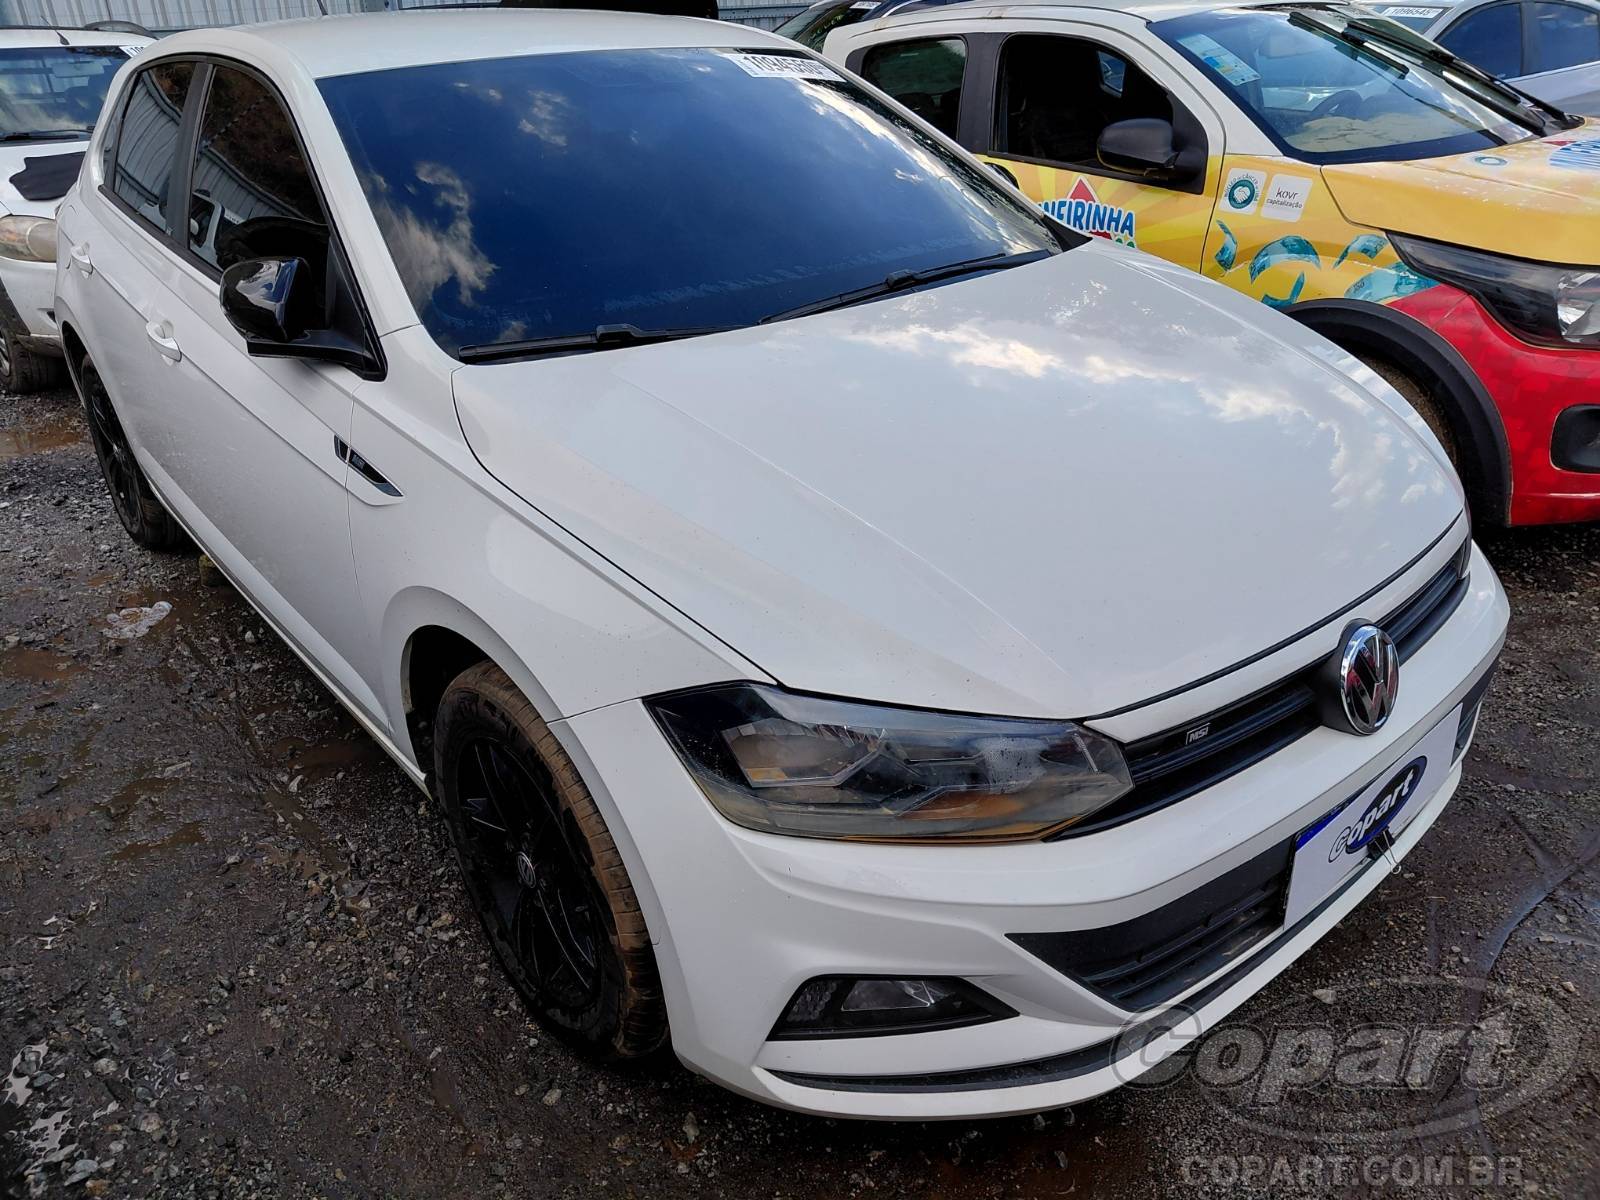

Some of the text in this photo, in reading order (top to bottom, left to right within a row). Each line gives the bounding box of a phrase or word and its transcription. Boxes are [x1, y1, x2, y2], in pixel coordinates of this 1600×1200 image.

[743, 55, 824, 75] 1094550
[1275, 186, 1299, 200] kovr
[1039, 200, 1134, 238] NEIRINHA
[1328, 768, 1415, 863] Copart
